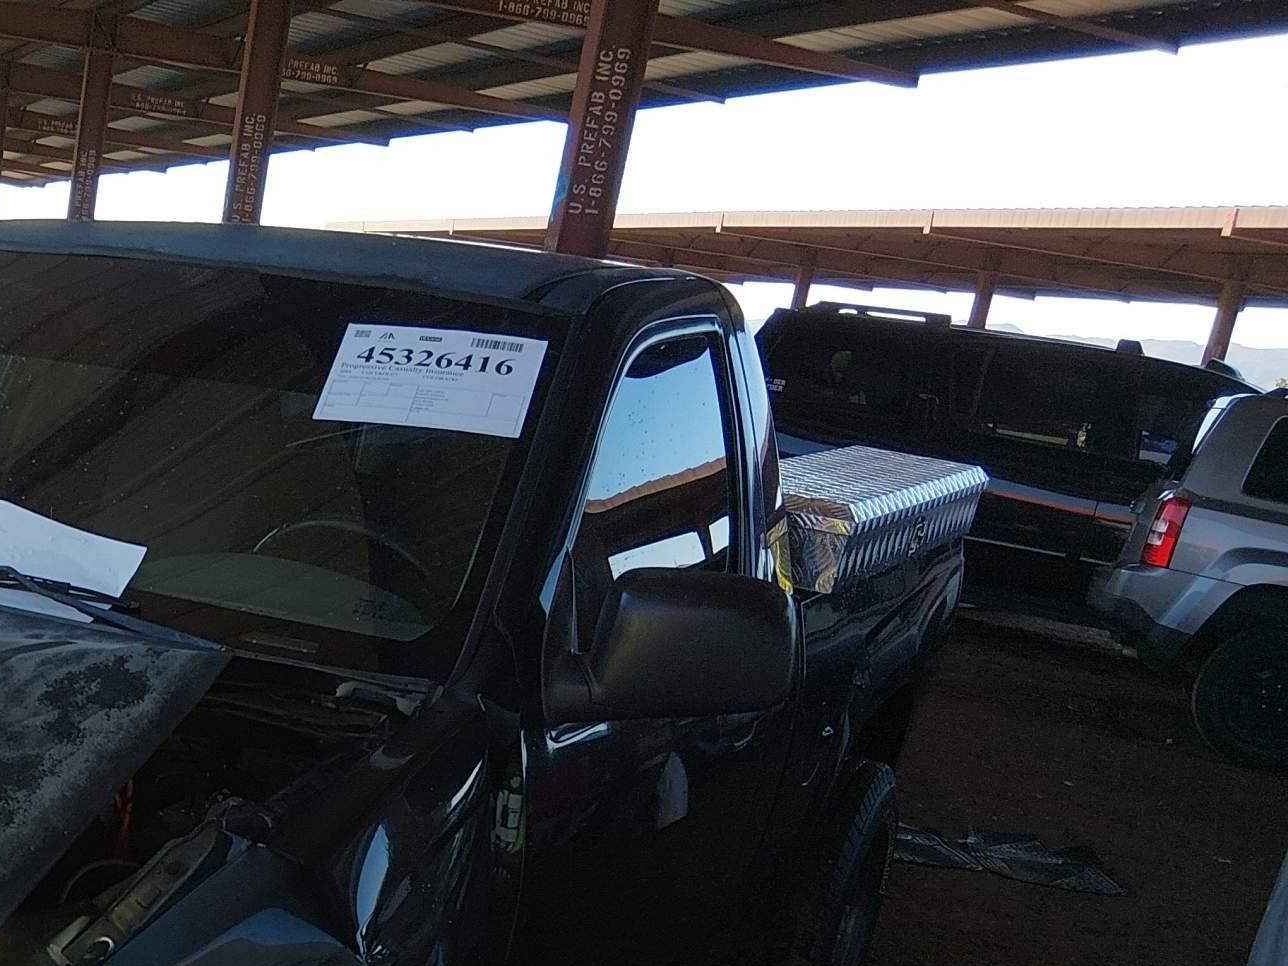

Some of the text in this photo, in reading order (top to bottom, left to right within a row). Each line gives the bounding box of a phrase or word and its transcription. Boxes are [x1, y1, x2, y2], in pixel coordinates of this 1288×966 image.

[568, 45, 617, 214] U.S. PREFAB INC.
[585, 47, 631, 215] 1-866-799-0969
[235, 144, 252, 193] PREFAB
[341, 362, 388, 371] Progressive
[425, 368, 465, 377] Insurance
[356, 346, 516, 375] 45326416
